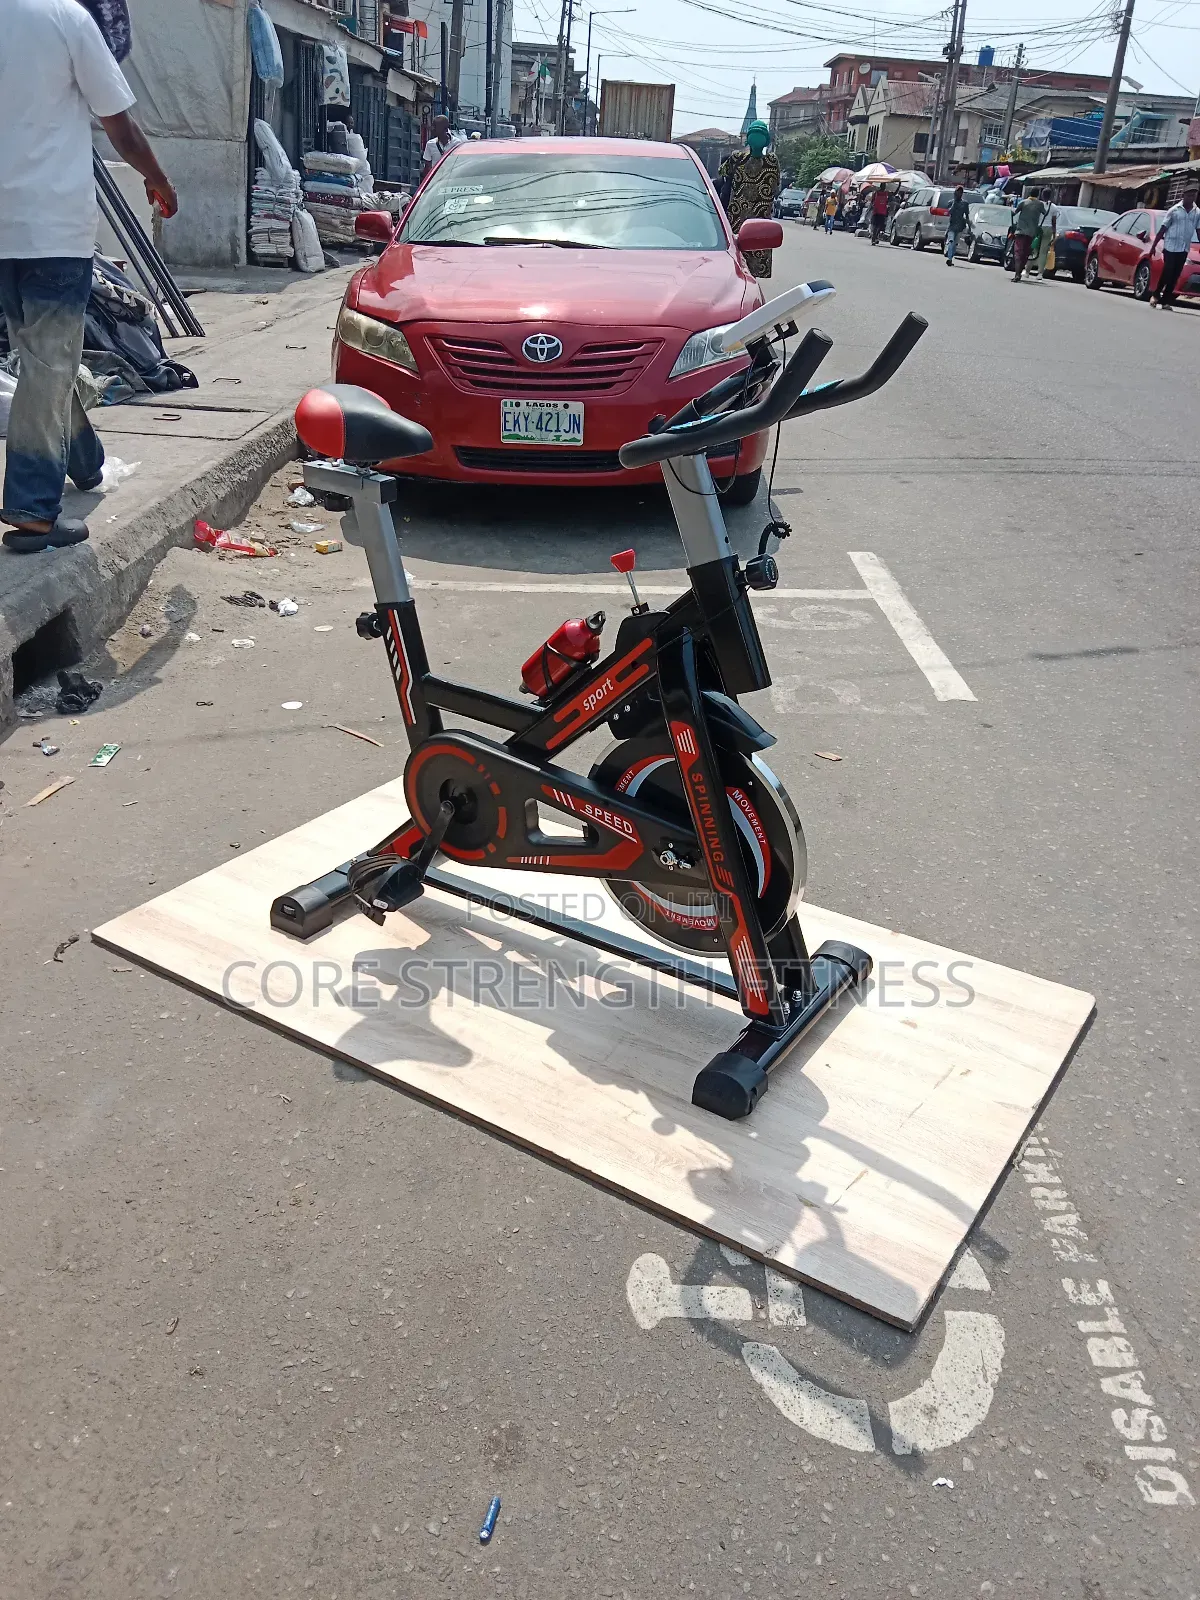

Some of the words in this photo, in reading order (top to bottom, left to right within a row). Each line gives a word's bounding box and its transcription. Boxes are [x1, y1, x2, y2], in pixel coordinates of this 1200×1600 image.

[583, 677, 614, 711] sport
[585, 804, 633, 834] SPEED
[691, 772, 724, 862] SPINNING
[732, 789, 767, 845] MOVEMENT
[1061, 1276, 1197, 1506] DISABLE
